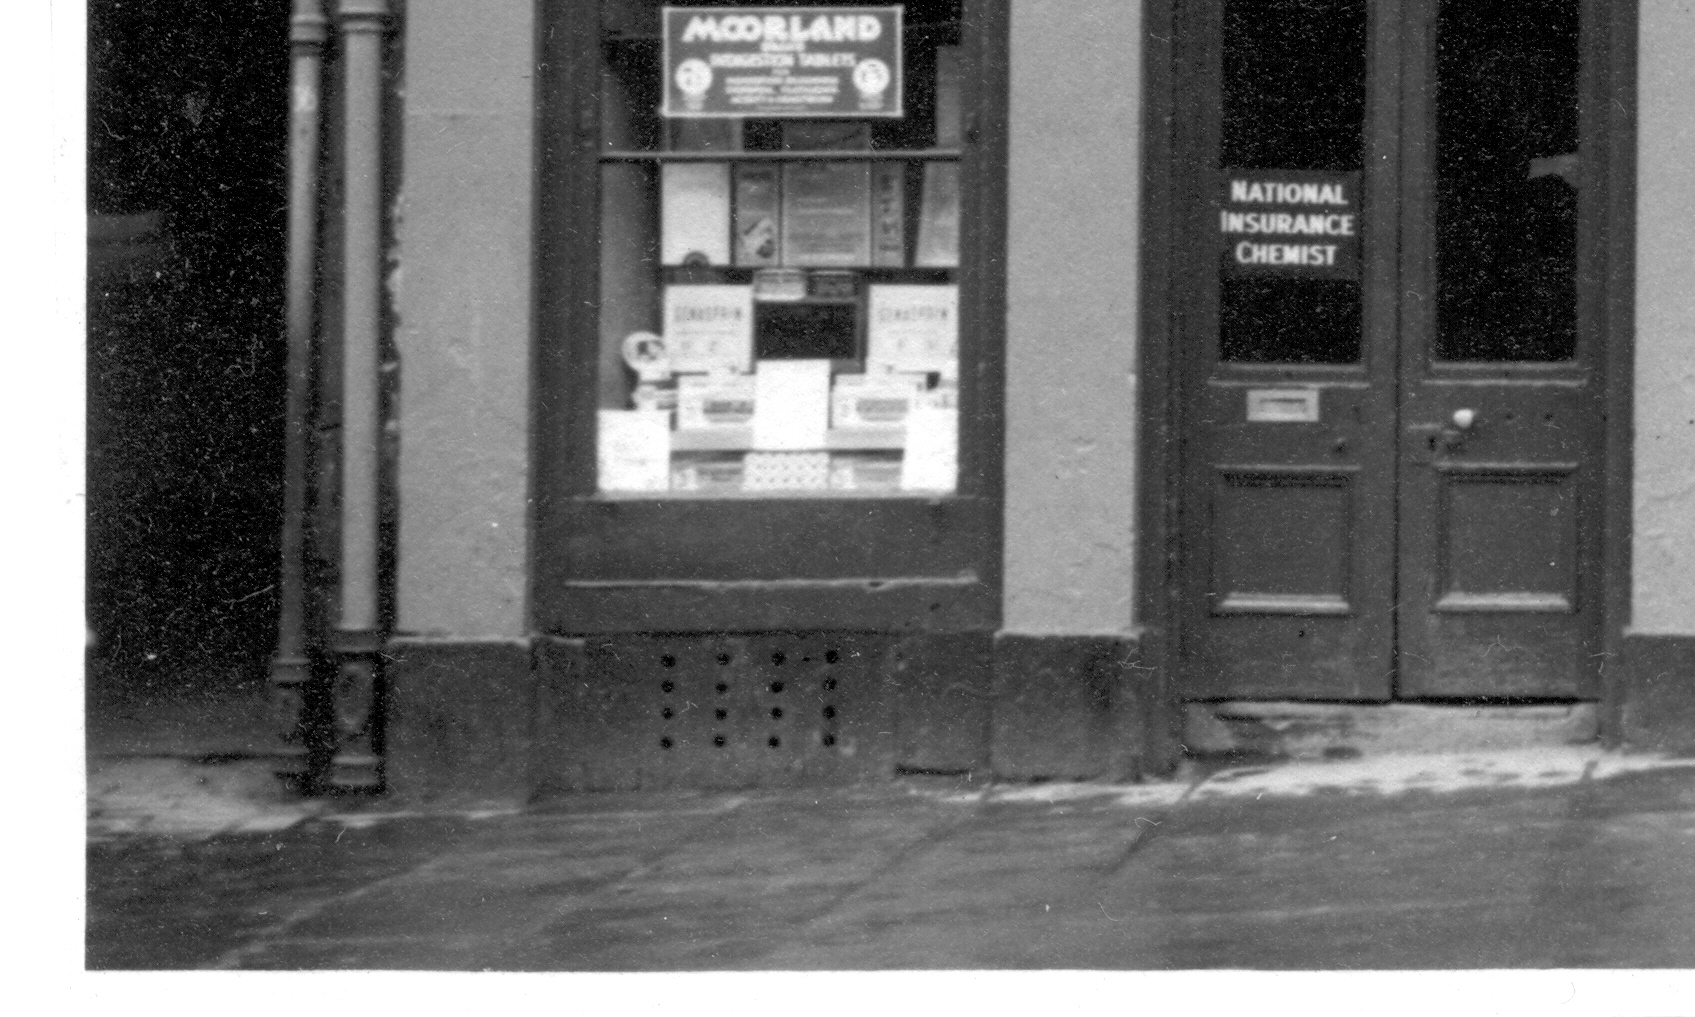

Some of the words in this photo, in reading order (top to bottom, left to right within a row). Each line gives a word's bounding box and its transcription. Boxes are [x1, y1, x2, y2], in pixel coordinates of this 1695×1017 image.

[682, 14, 882, 43] MOORLAND
[1230, 180, 1349, 206] NATIONAL
[1220, 210, 1355, 237] INSURANCE
[1235, 241, 1337, 266] CHEMIST
